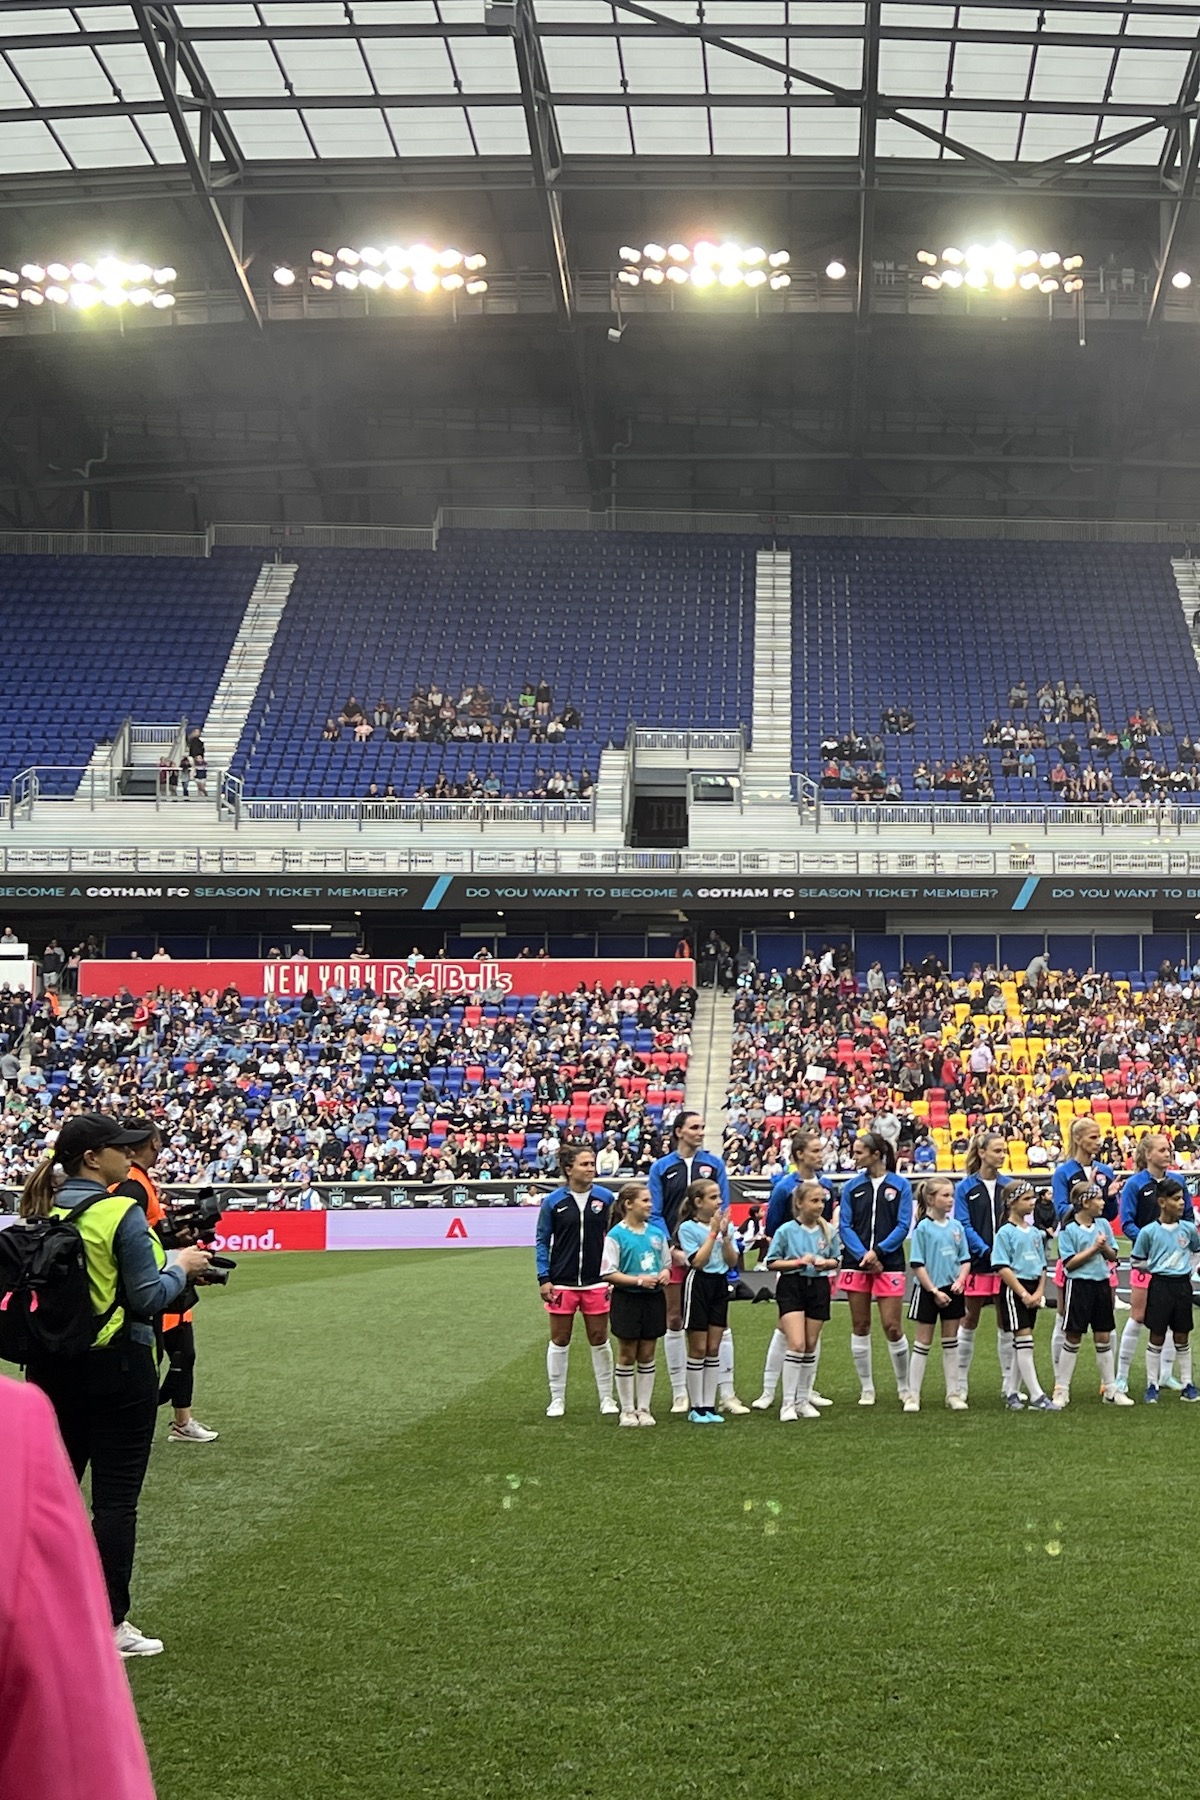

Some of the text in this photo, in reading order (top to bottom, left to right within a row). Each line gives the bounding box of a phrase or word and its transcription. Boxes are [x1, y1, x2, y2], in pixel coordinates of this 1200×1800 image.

[69, 887, 82, 896] A
[85, 887, 162, 898] GOTHAM
[166, 887, 190, 898] FC
[194, 887, 261, 897] SEASON
[266, 887, 323, 897] TICKET
[327, 887, 408, 897] MEMBER?
[465, 887, 999, 898] DO YOU WANT TO BECOME A GOTHAM FC SEASON TICKET MEMBER?
[1051, 888, 1075, 898] DO
[1079, 888, 1110, 898] YOU
[1113, 888, 1158, 898] WANT
[1162, 888, 1183, 898] TO
[263, 964, 309, 994] NEW
[319, 964, 376, 993] YORK
